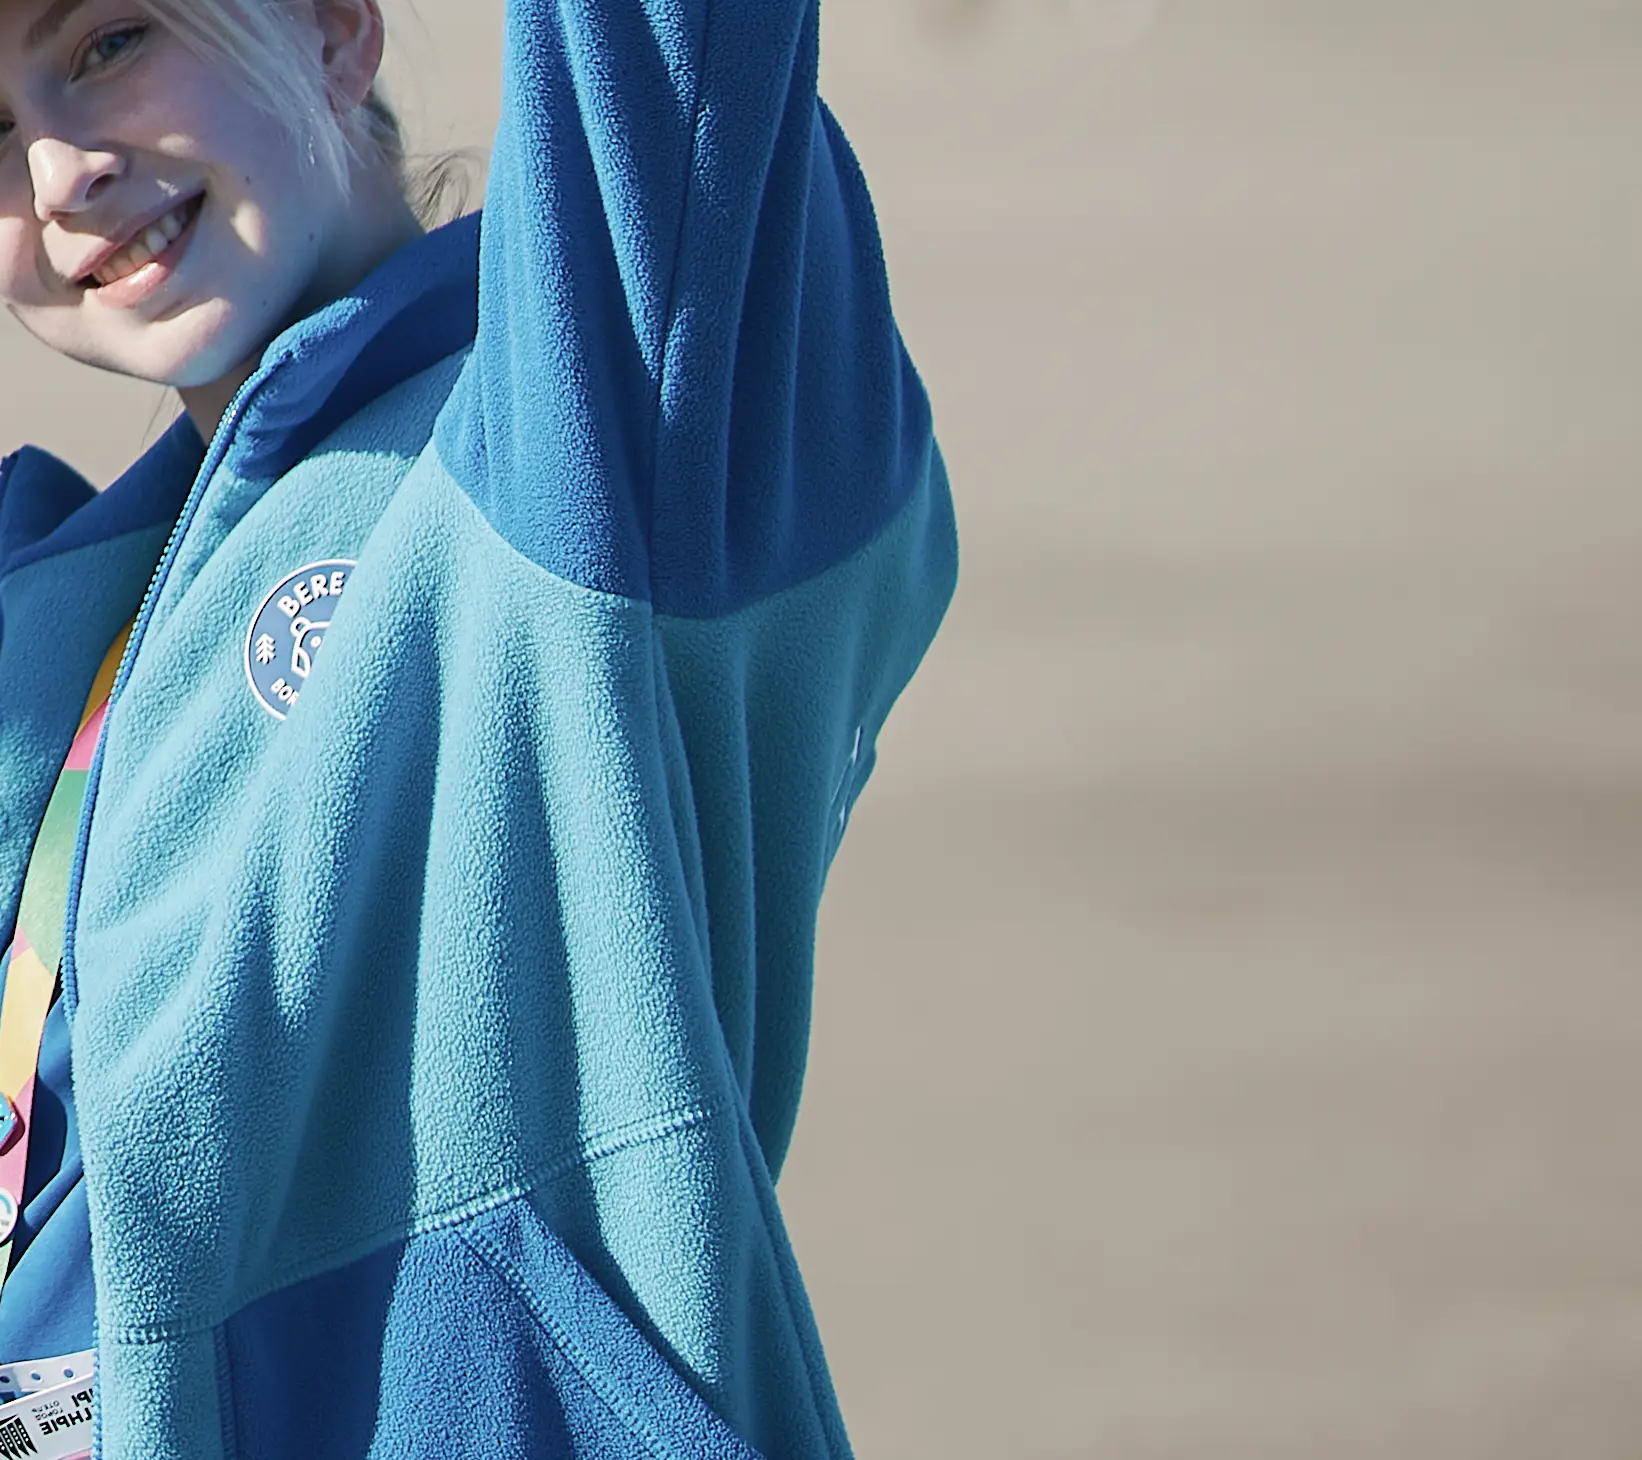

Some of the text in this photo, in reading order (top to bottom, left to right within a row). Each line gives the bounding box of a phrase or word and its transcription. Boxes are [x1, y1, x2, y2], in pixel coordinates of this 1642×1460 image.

[277, 571, 346, 618] BERE
[271, 678, 301, 705] BOR
[39, 1406, 93, 1435] ТНЫЕ
